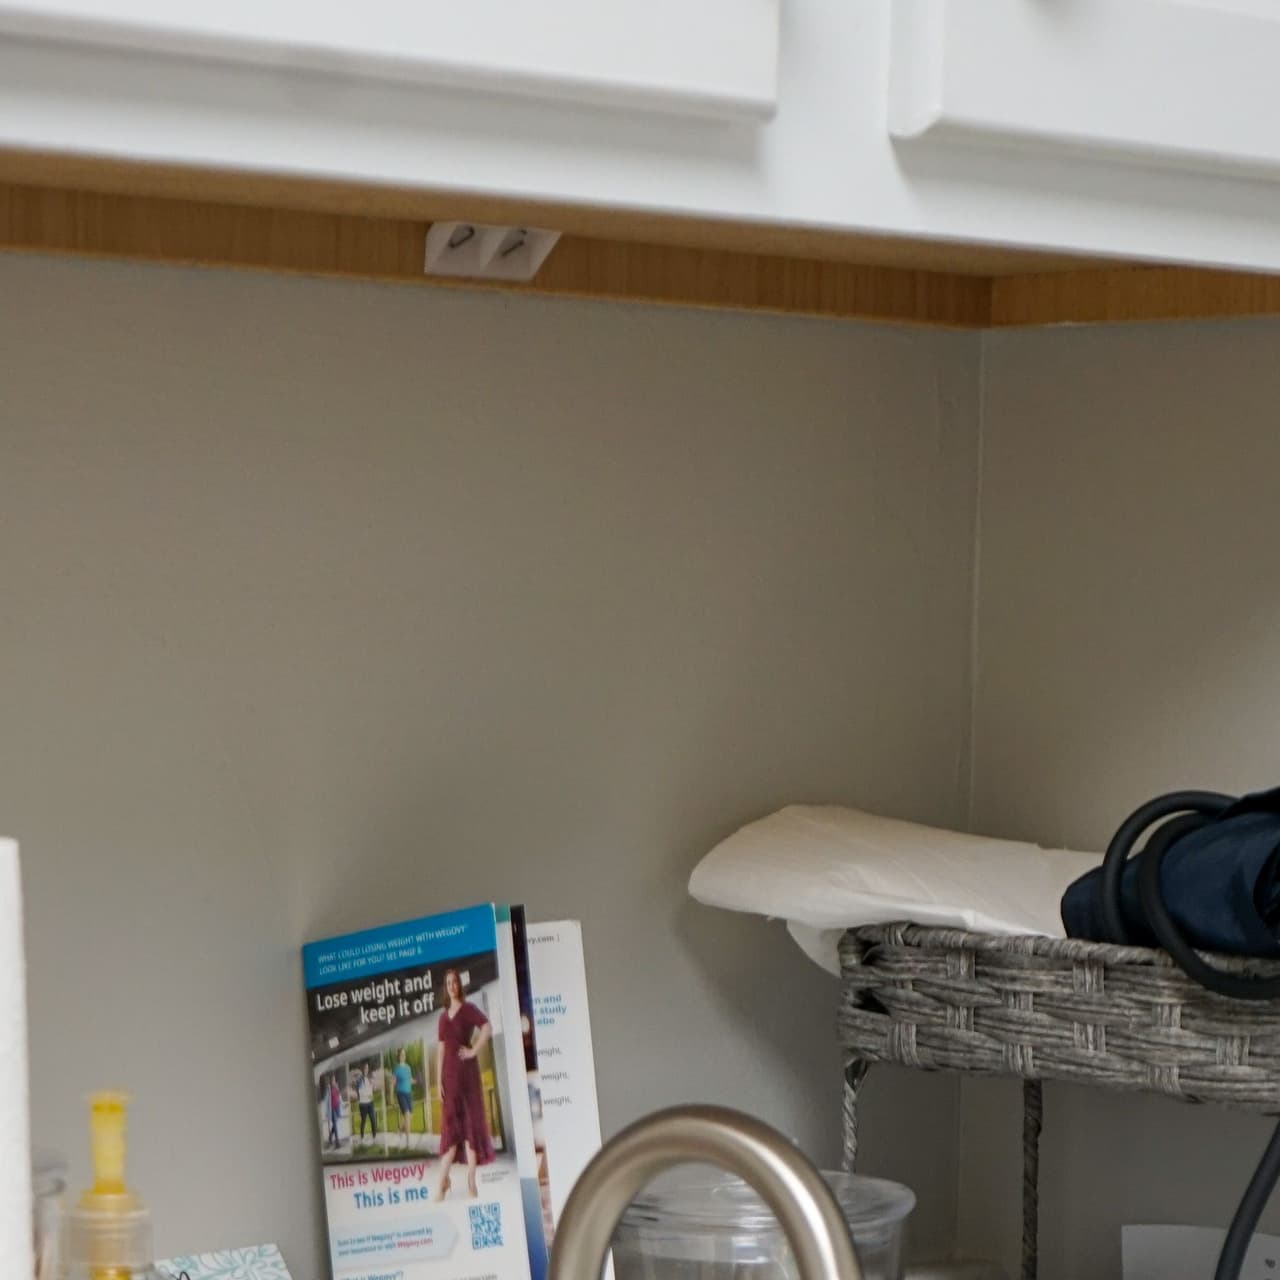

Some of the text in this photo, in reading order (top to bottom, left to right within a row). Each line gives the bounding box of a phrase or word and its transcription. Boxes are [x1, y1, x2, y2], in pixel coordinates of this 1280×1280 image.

[317, 969, 433, 1011] Lose weight and
[360, 992, 435, 1024] keep it off
[330, 1173, 355, 1190] This
[358, 1169, 369, 1185] is
[354, 1185, 430, 1209] This is me
